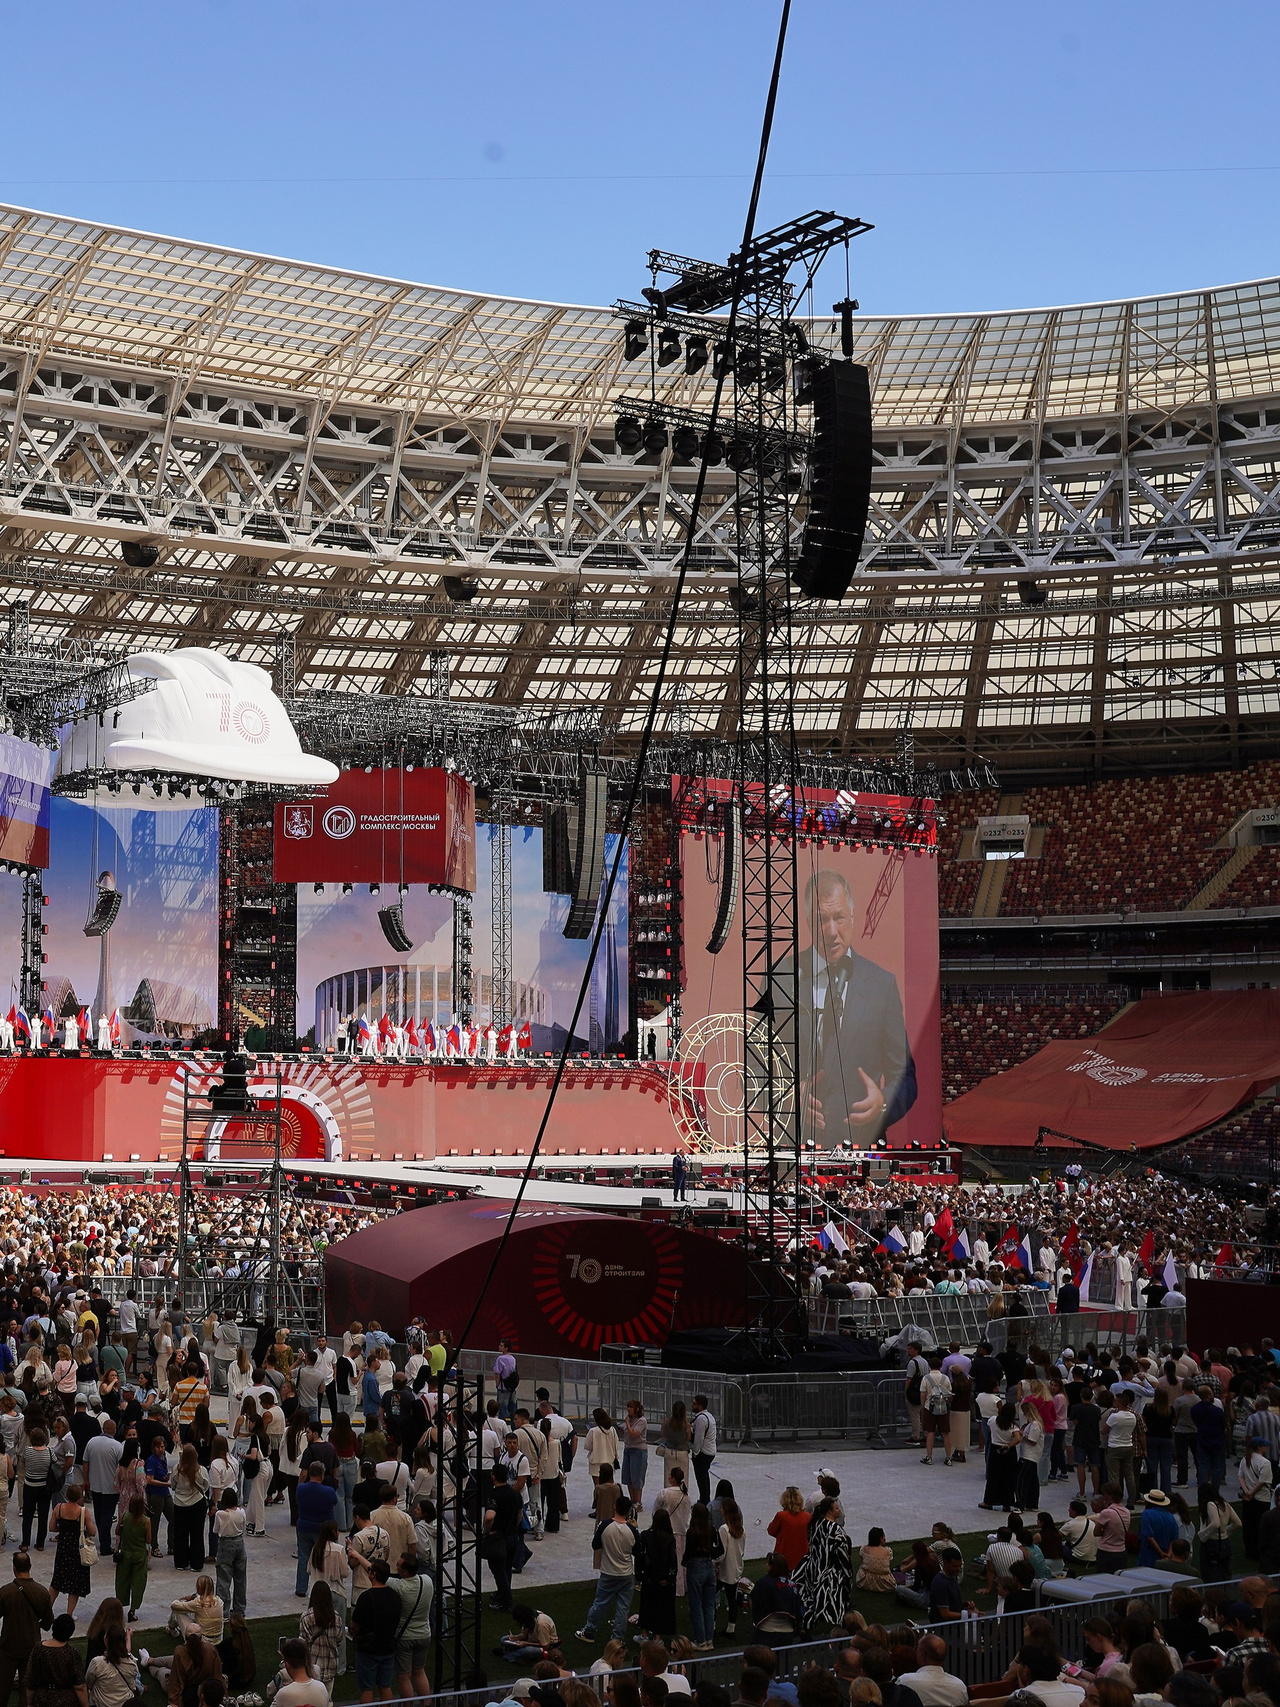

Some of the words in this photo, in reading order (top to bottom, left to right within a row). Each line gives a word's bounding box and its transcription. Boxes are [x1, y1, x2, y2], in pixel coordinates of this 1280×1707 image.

[360, 813, 441, 822] ГРАДОСТРОИТЕЛЬНЫЙ
[1261, 814, 1276, 822] 230
[566, 1254, 602, 1283] 70
